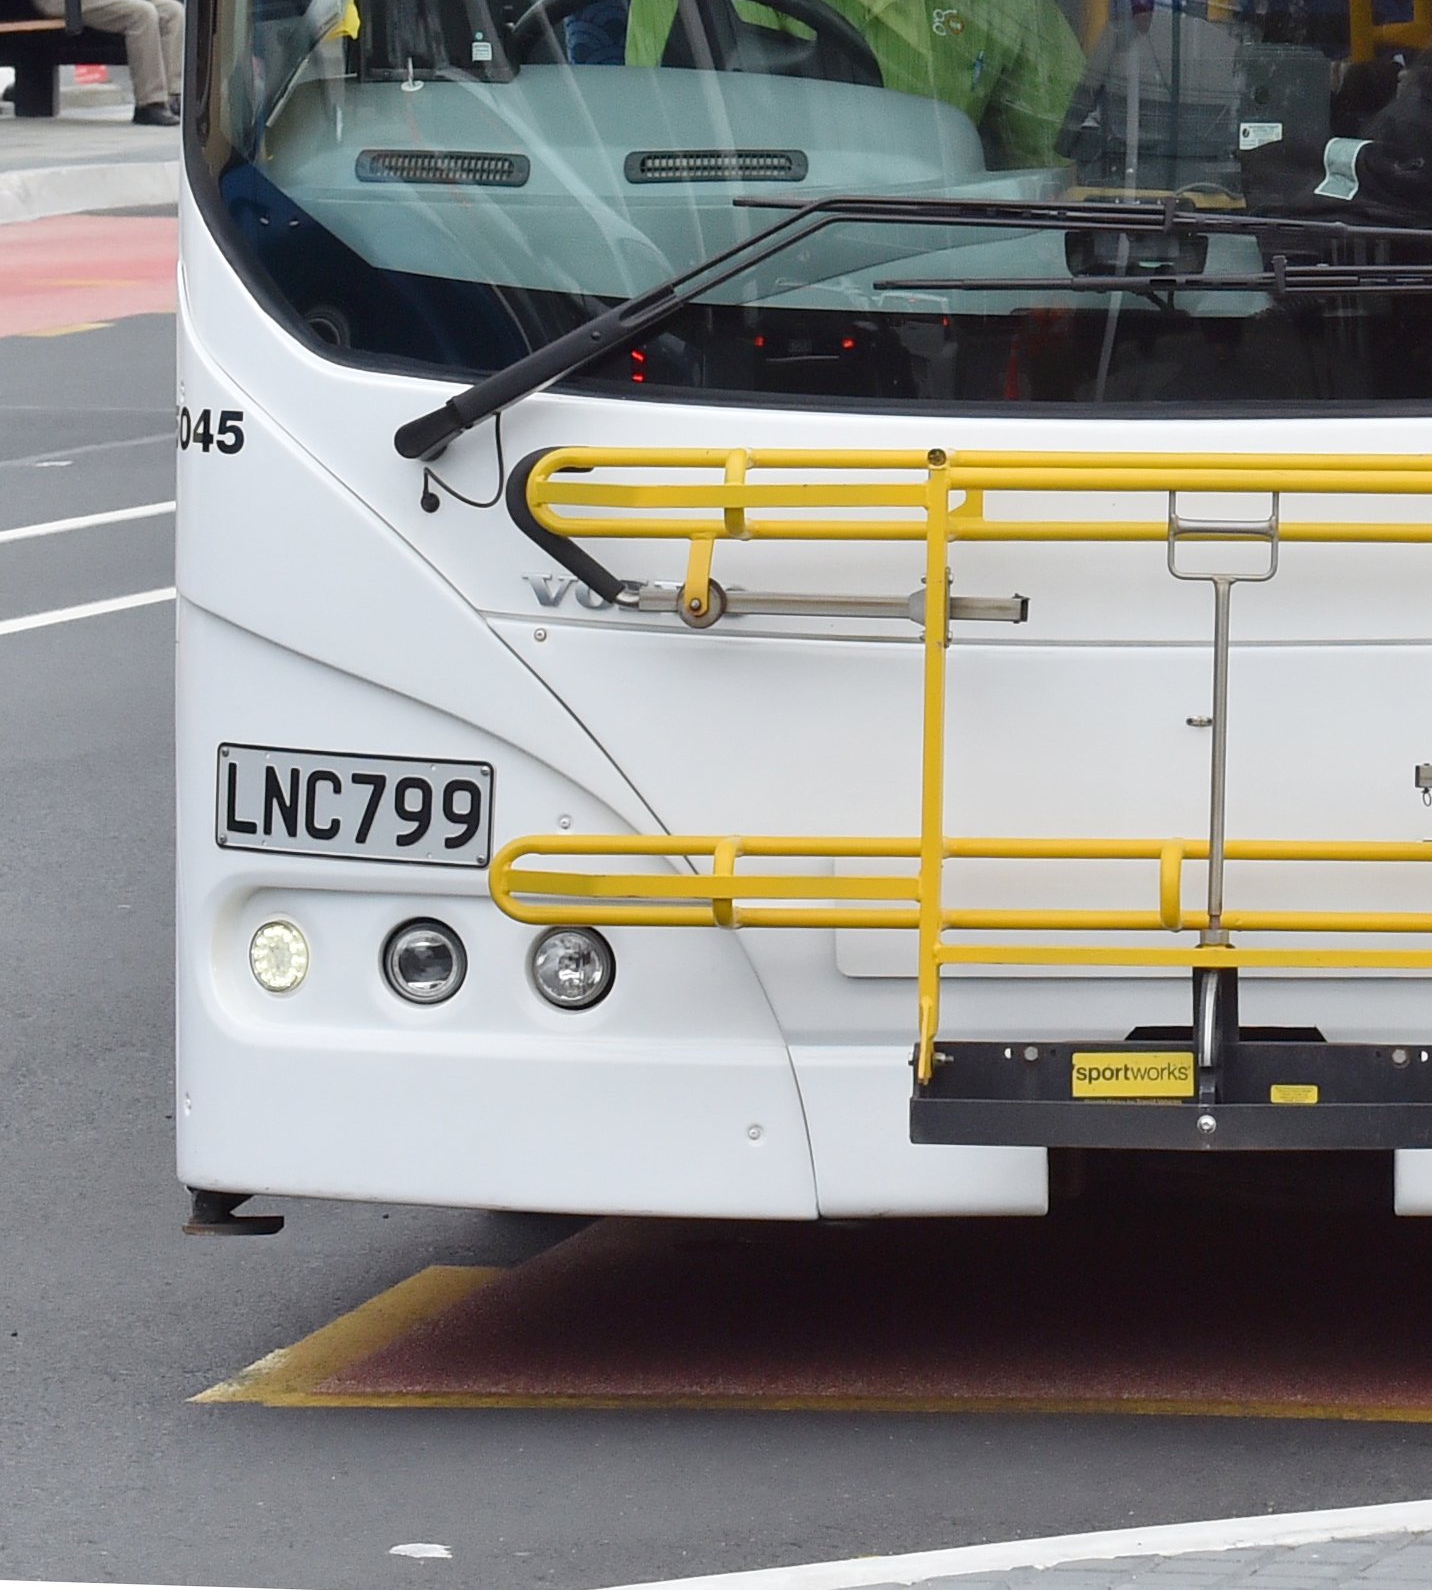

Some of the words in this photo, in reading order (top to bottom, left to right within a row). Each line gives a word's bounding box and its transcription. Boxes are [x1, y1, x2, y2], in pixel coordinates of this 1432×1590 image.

[176, 405, 245, 455] 045
[224, 761, 484, 850] LNC799
[1075, 1062, 1190, 1085] sportworks
